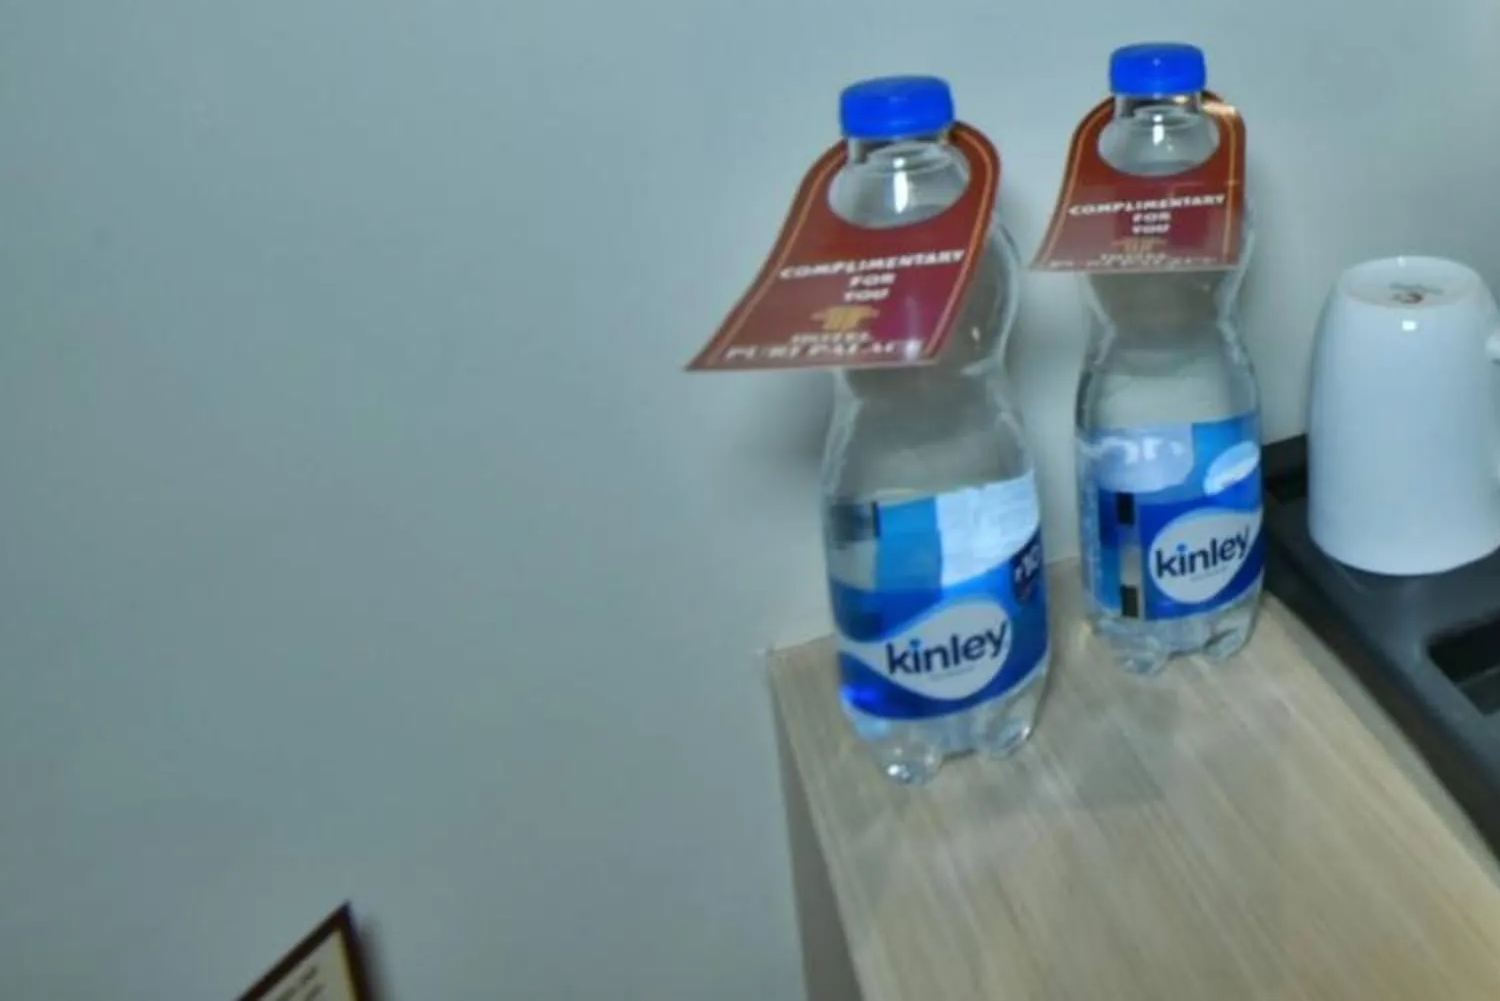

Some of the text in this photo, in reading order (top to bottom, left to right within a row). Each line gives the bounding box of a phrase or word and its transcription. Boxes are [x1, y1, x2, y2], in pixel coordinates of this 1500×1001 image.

[1069, 195, 1225, 216] COMPLIMENTARY
[1132, 212, 1171, 223] FOR
[1132, 224, 1170, 234] YOU
[779, 249, 965, 279] COMPLIMENTARY
[850, 272, 897, 288] FOR
[844, 287, 889, 302] YOU
[1155, 523, 1250, 579] kinley
[885, 619, 1008, 675] kinley
